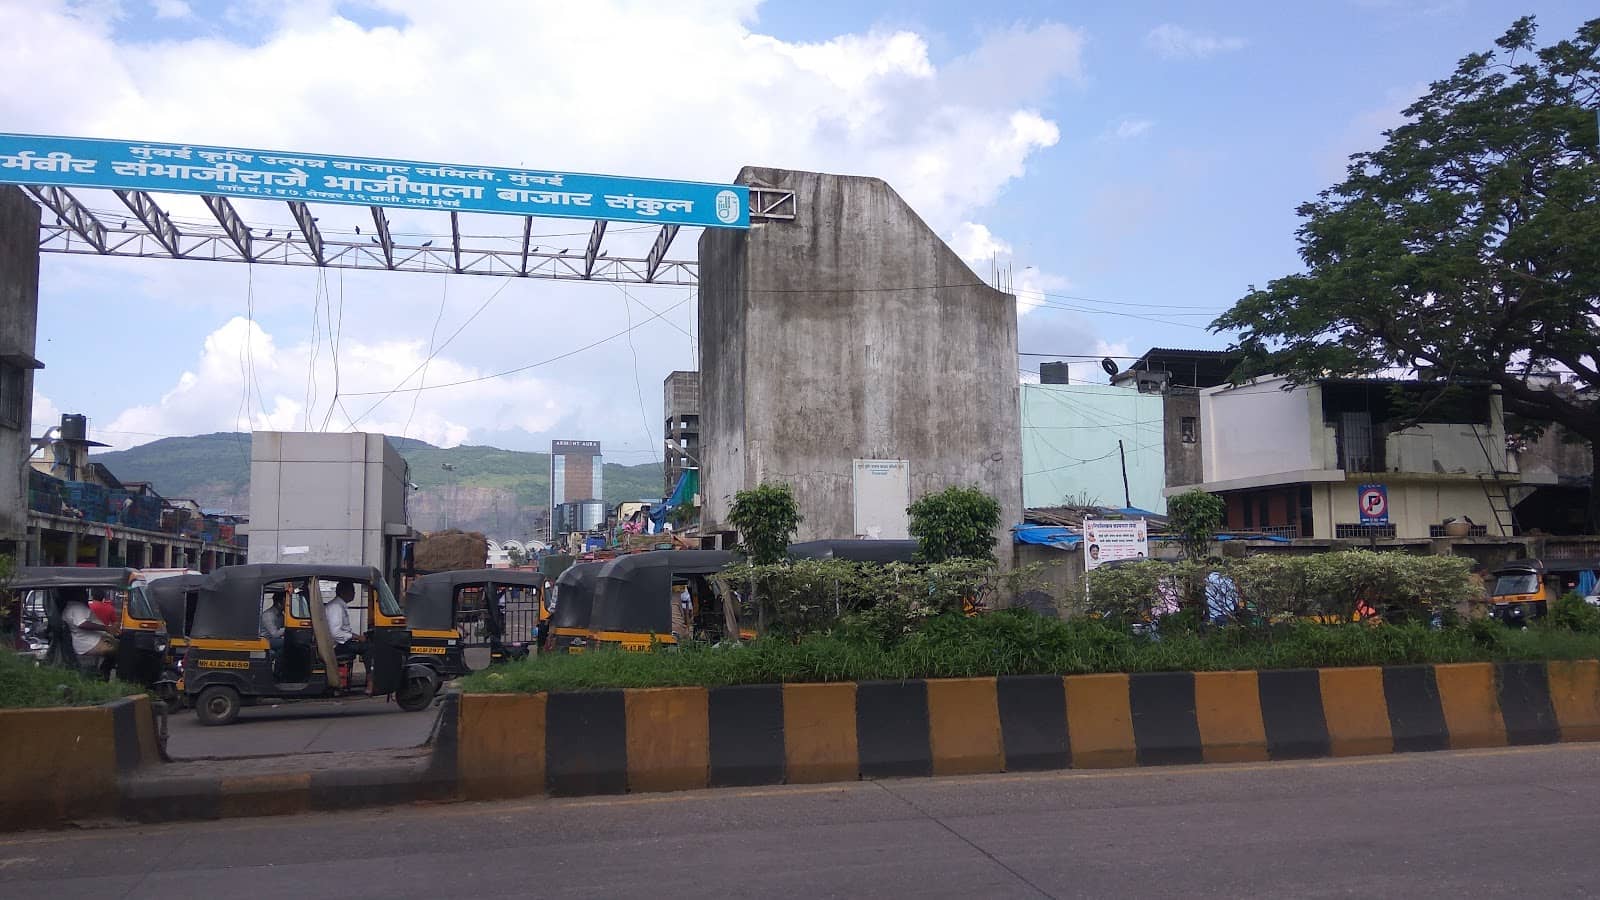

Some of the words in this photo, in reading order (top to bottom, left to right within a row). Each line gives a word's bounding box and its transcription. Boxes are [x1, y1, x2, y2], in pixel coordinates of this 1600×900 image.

[111, 159, 309, 188] संभाजीराजे
[323, 173, 485, 200] भाजीपाला
[496, 187, 593, 207] बाजार
[603, 193, 695, 217] संकुल
[128, 145, 192, 160] मुंबई
[198, 150, 254, 164] कृषि
[259, 156, 328, 169] उत्पन्न
[332, 160, 411, 174] बाजार
[508, 172, 564, 187] मुंबई
